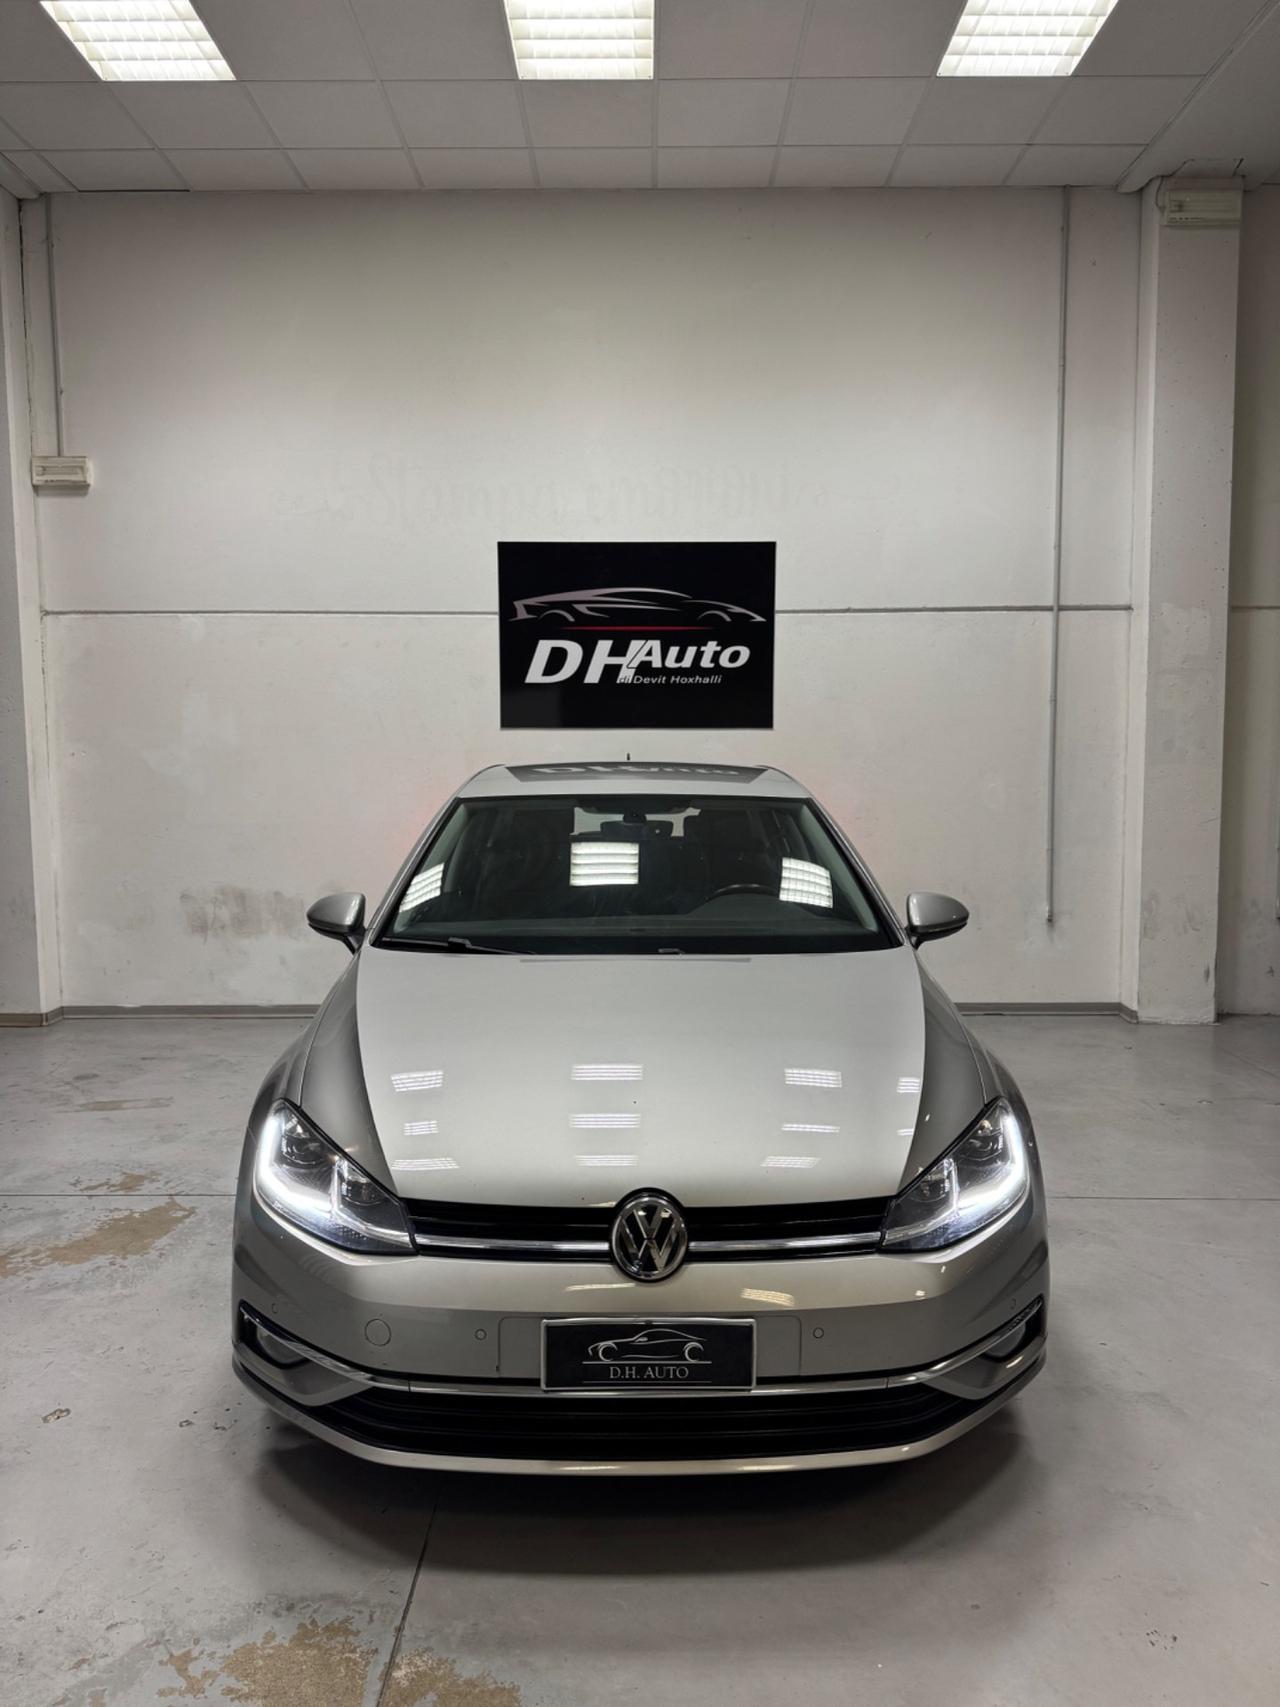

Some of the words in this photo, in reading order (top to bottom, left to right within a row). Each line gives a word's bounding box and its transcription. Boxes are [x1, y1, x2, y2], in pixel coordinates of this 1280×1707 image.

[633, 675, 667, 684] Devit
[670, 675, 722, 684] Hoxhalli
[609, 1366, 640, 1379] D.H.
[643, 1366, 689, 1379] AUTO
